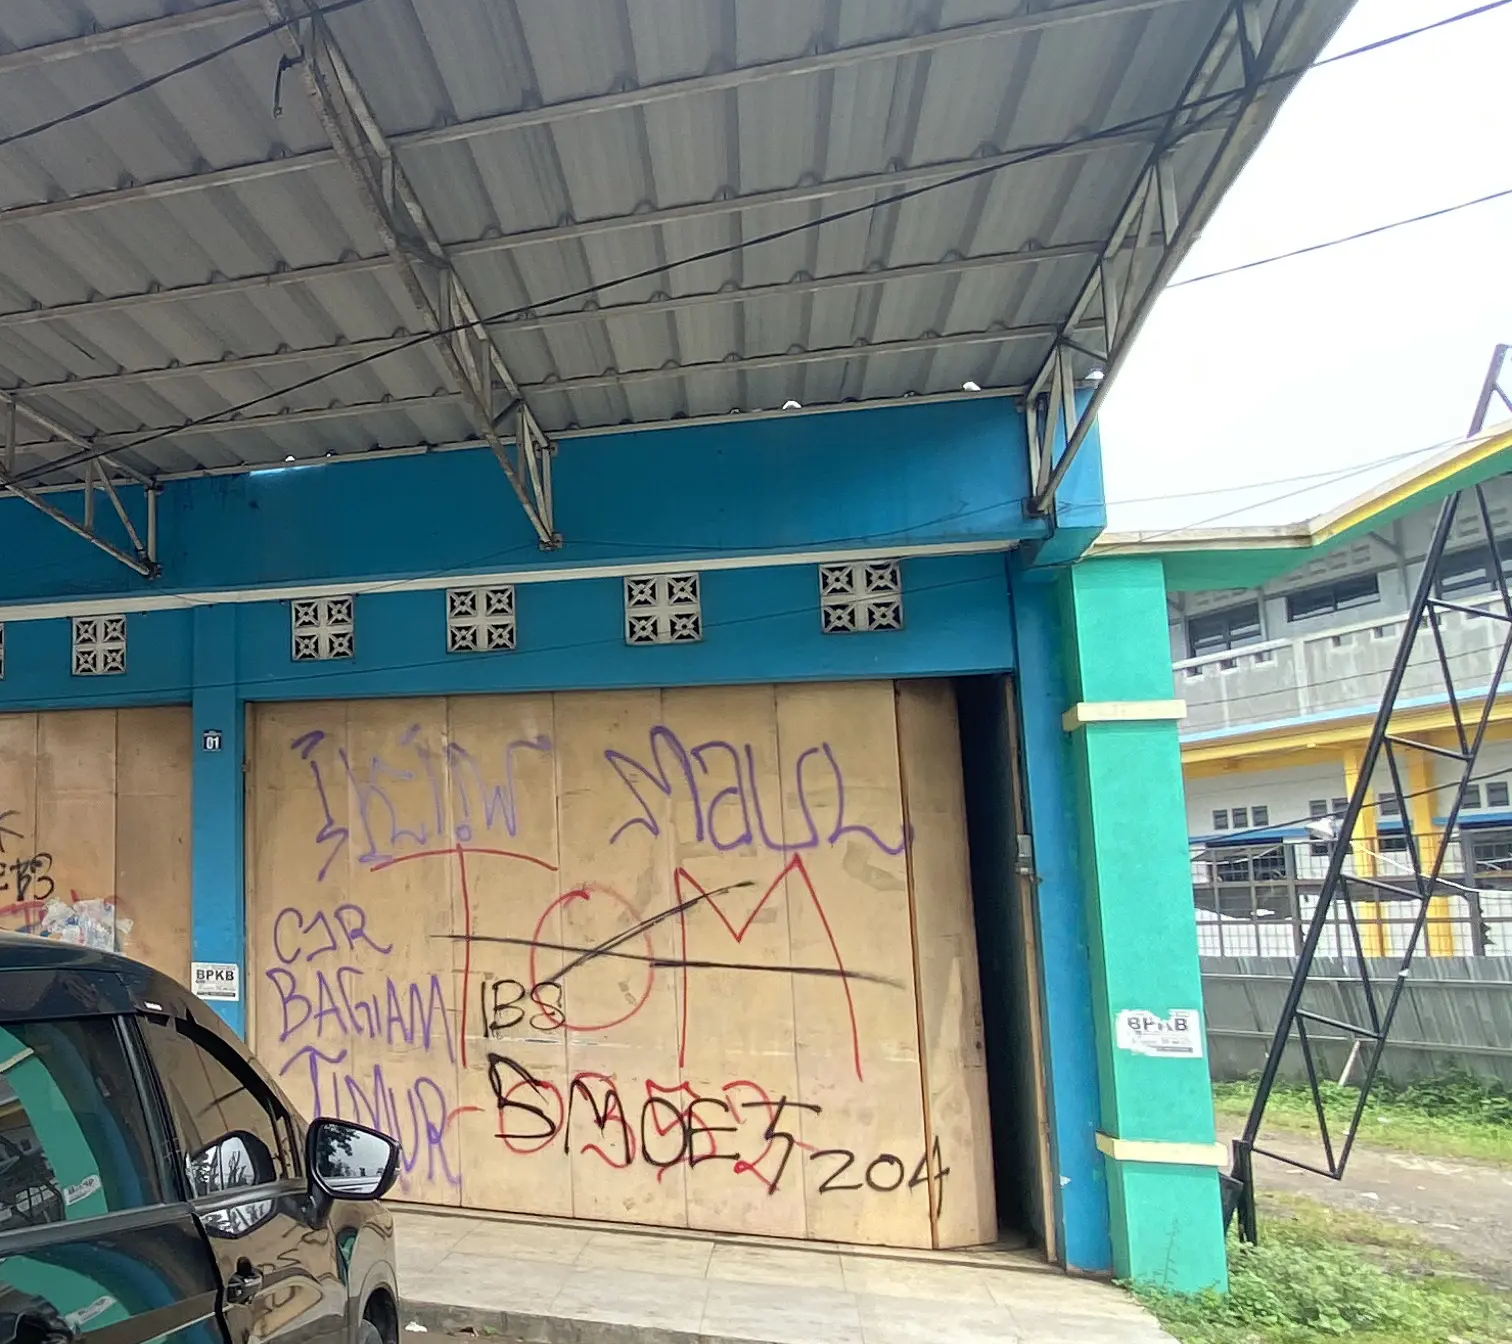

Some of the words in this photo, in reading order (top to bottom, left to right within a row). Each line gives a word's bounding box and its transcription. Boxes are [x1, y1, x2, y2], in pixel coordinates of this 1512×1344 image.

[206, 736, 220, 750] 01
[196, 969, 235, 981] BPKB
[810, 1135, 951, 1219] 204
